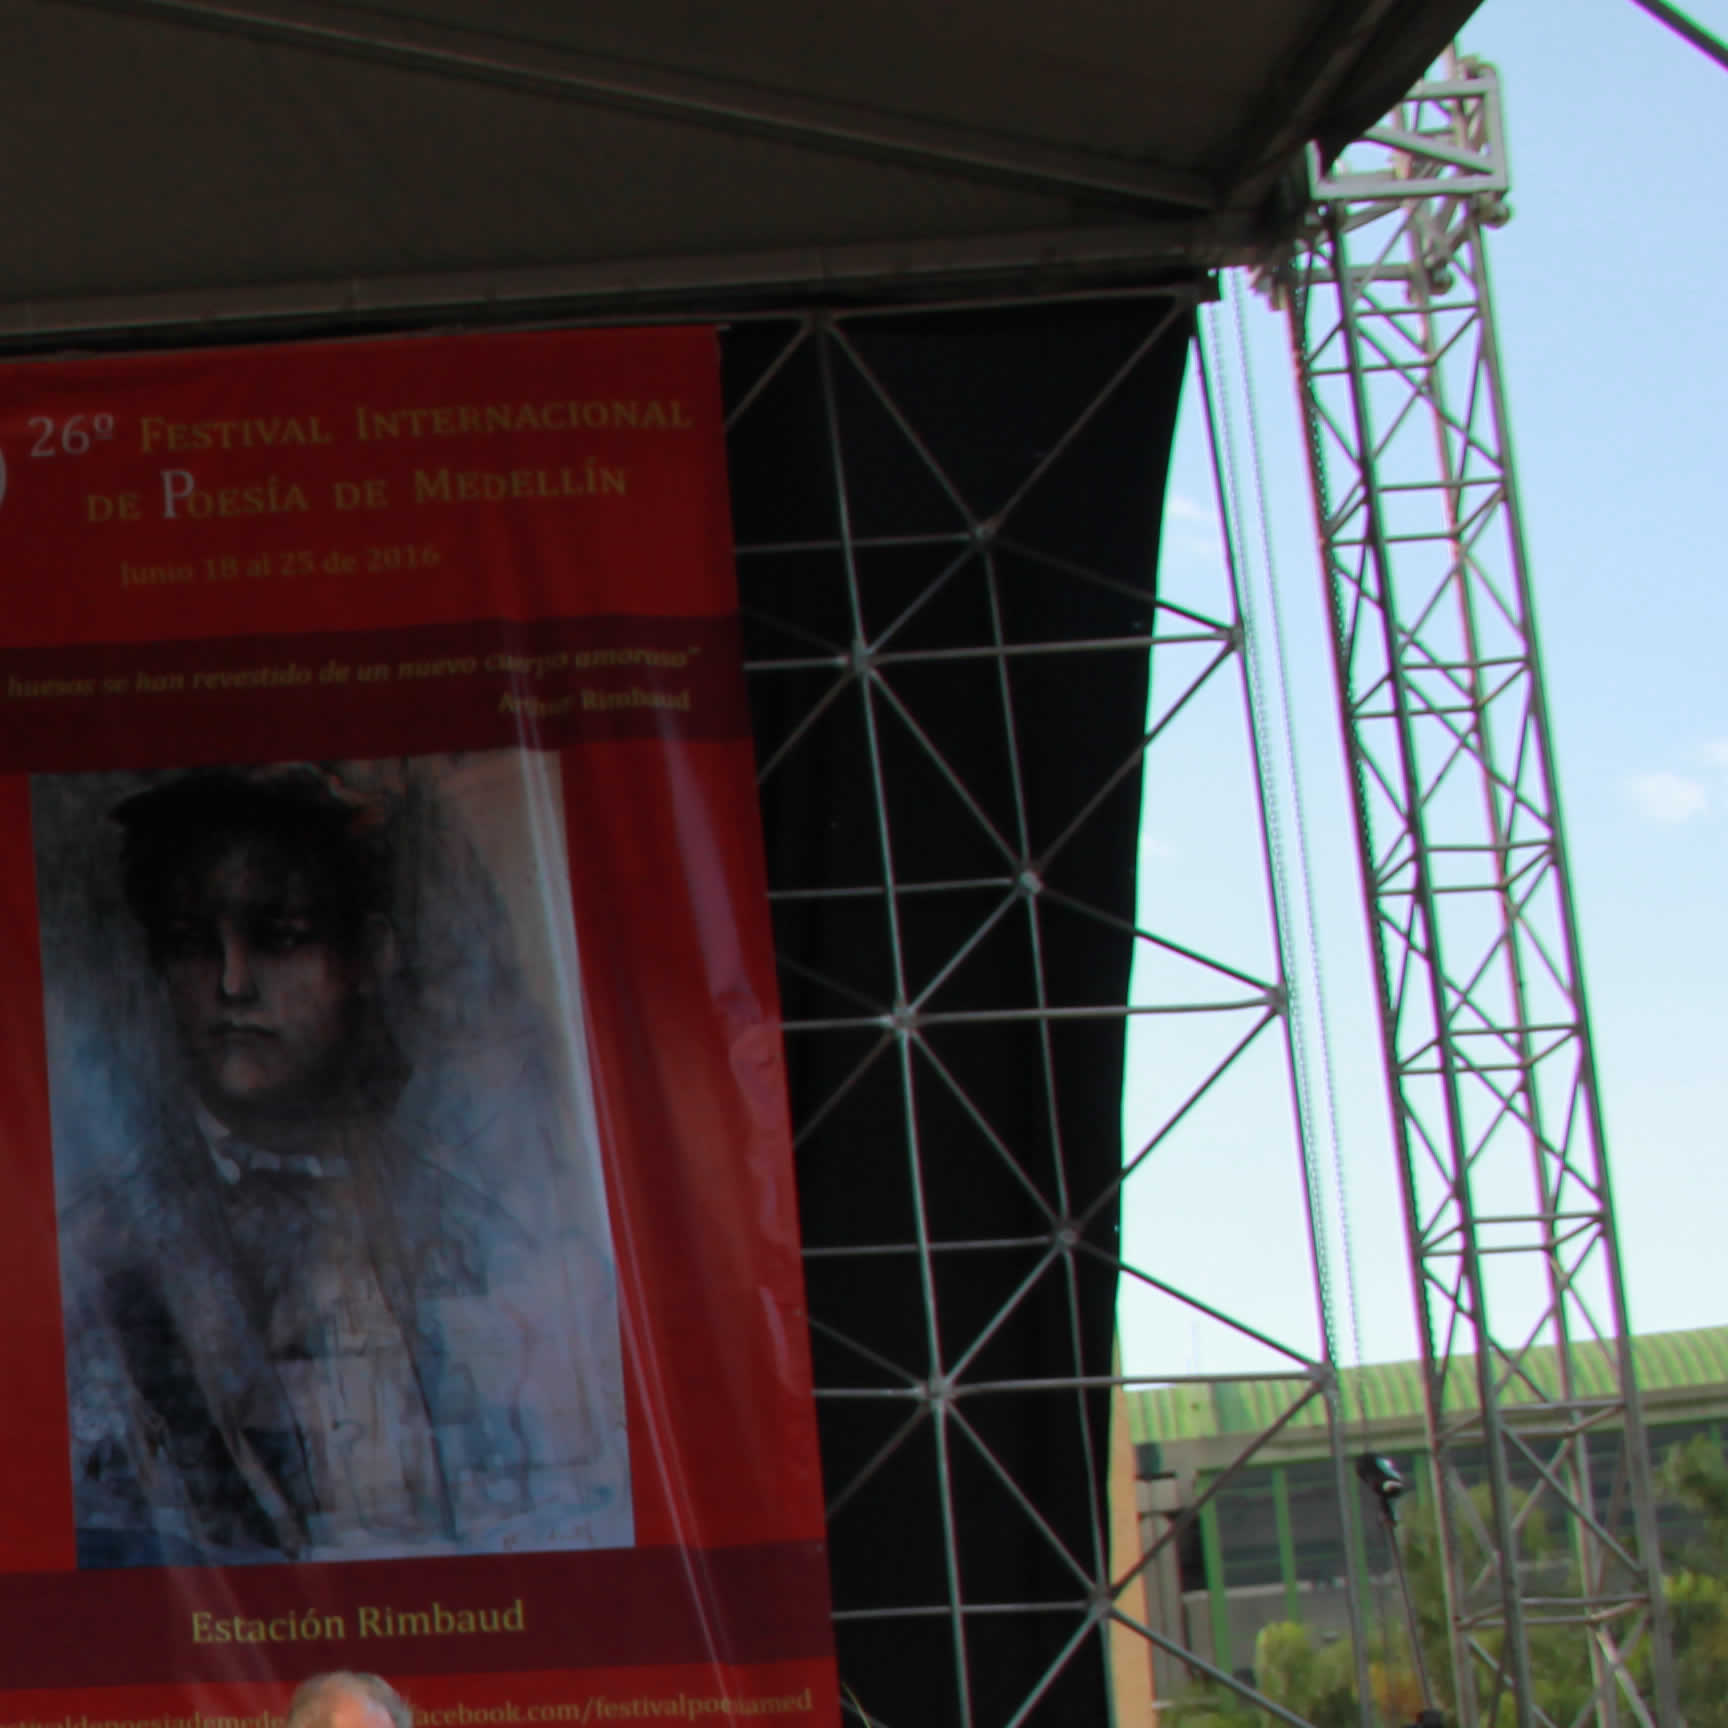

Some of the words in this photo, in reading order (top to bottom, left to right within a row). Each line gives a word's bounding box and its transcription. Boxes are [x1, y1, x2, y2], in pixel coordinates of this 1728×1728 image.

[27, 410, 115, 460] 26º
[138, 408, 332, 455] FESTIVAL
[353, 397, 694, 444] INTERNACIONAL
[85, 492, 141, 525] DE
[161, 468, 311, 521] POESÍA
[333, 479, 388, 512] DE
[413, 455, 629, 508] MEDELLÍN
[120, 559, 192, 591] Junio
[246, 551, 272, 579] al
[278, 549, 315, 577] 25
[322, 547, 357, 576] de
[366, 543, 441, 573] 2016
[136, 670, 184, 693] han
[318, 660, 352, 684] de
[357, 663, 391, 684] un
[190, 1608, 347, 1646] Estación
[357, 1600, 527, 1638] Rimbaud
